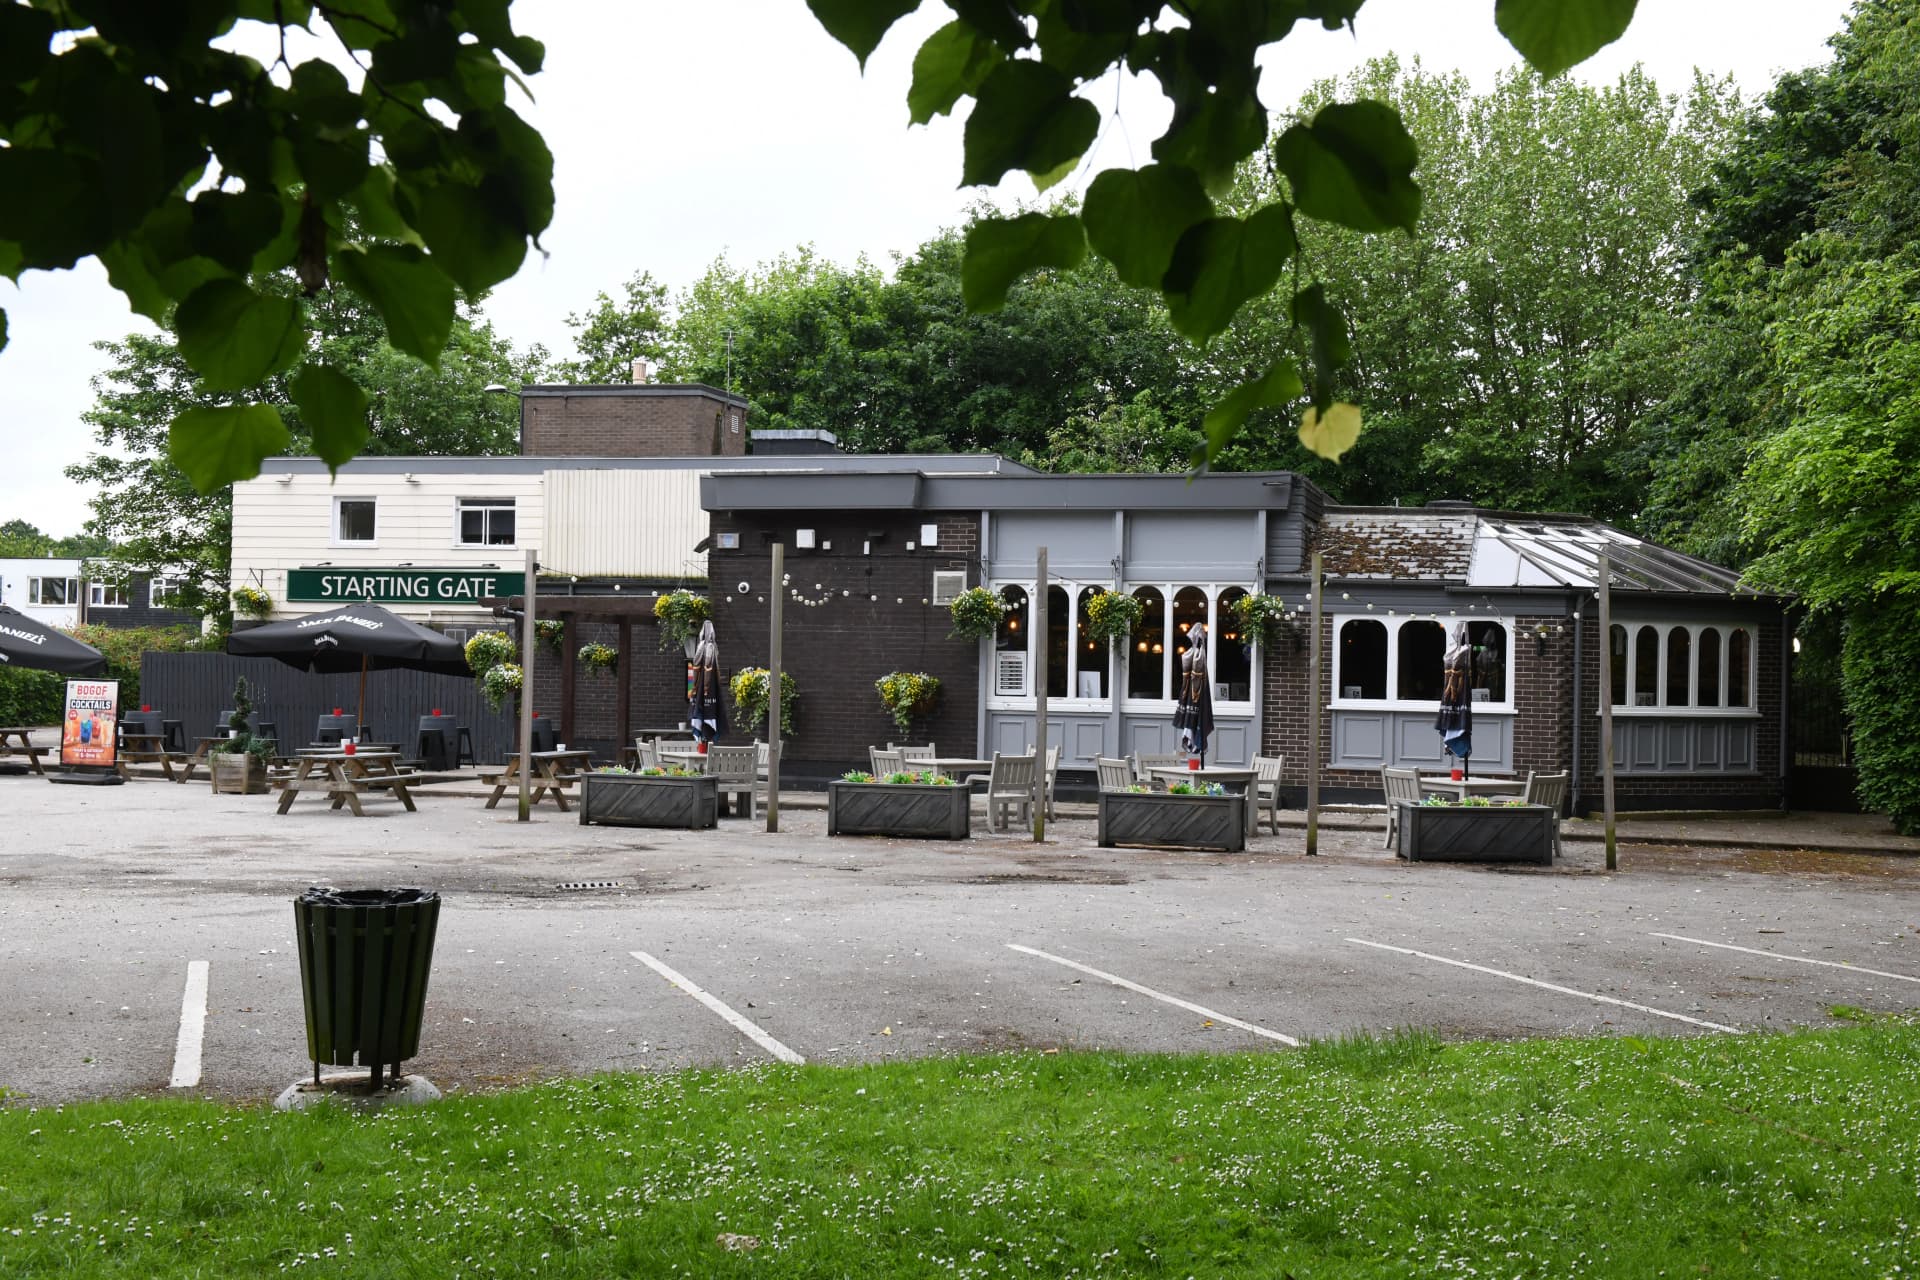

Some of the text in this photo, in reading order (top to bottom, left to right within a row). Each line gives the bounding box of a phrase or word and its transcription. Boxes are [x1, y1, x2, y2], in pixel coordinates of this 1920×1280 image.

[321, 576, 496, 598] STARTING GATE
[77, 685, 108, 695] BOGOF
[71, 700, 111, 709] COCKTAILS
